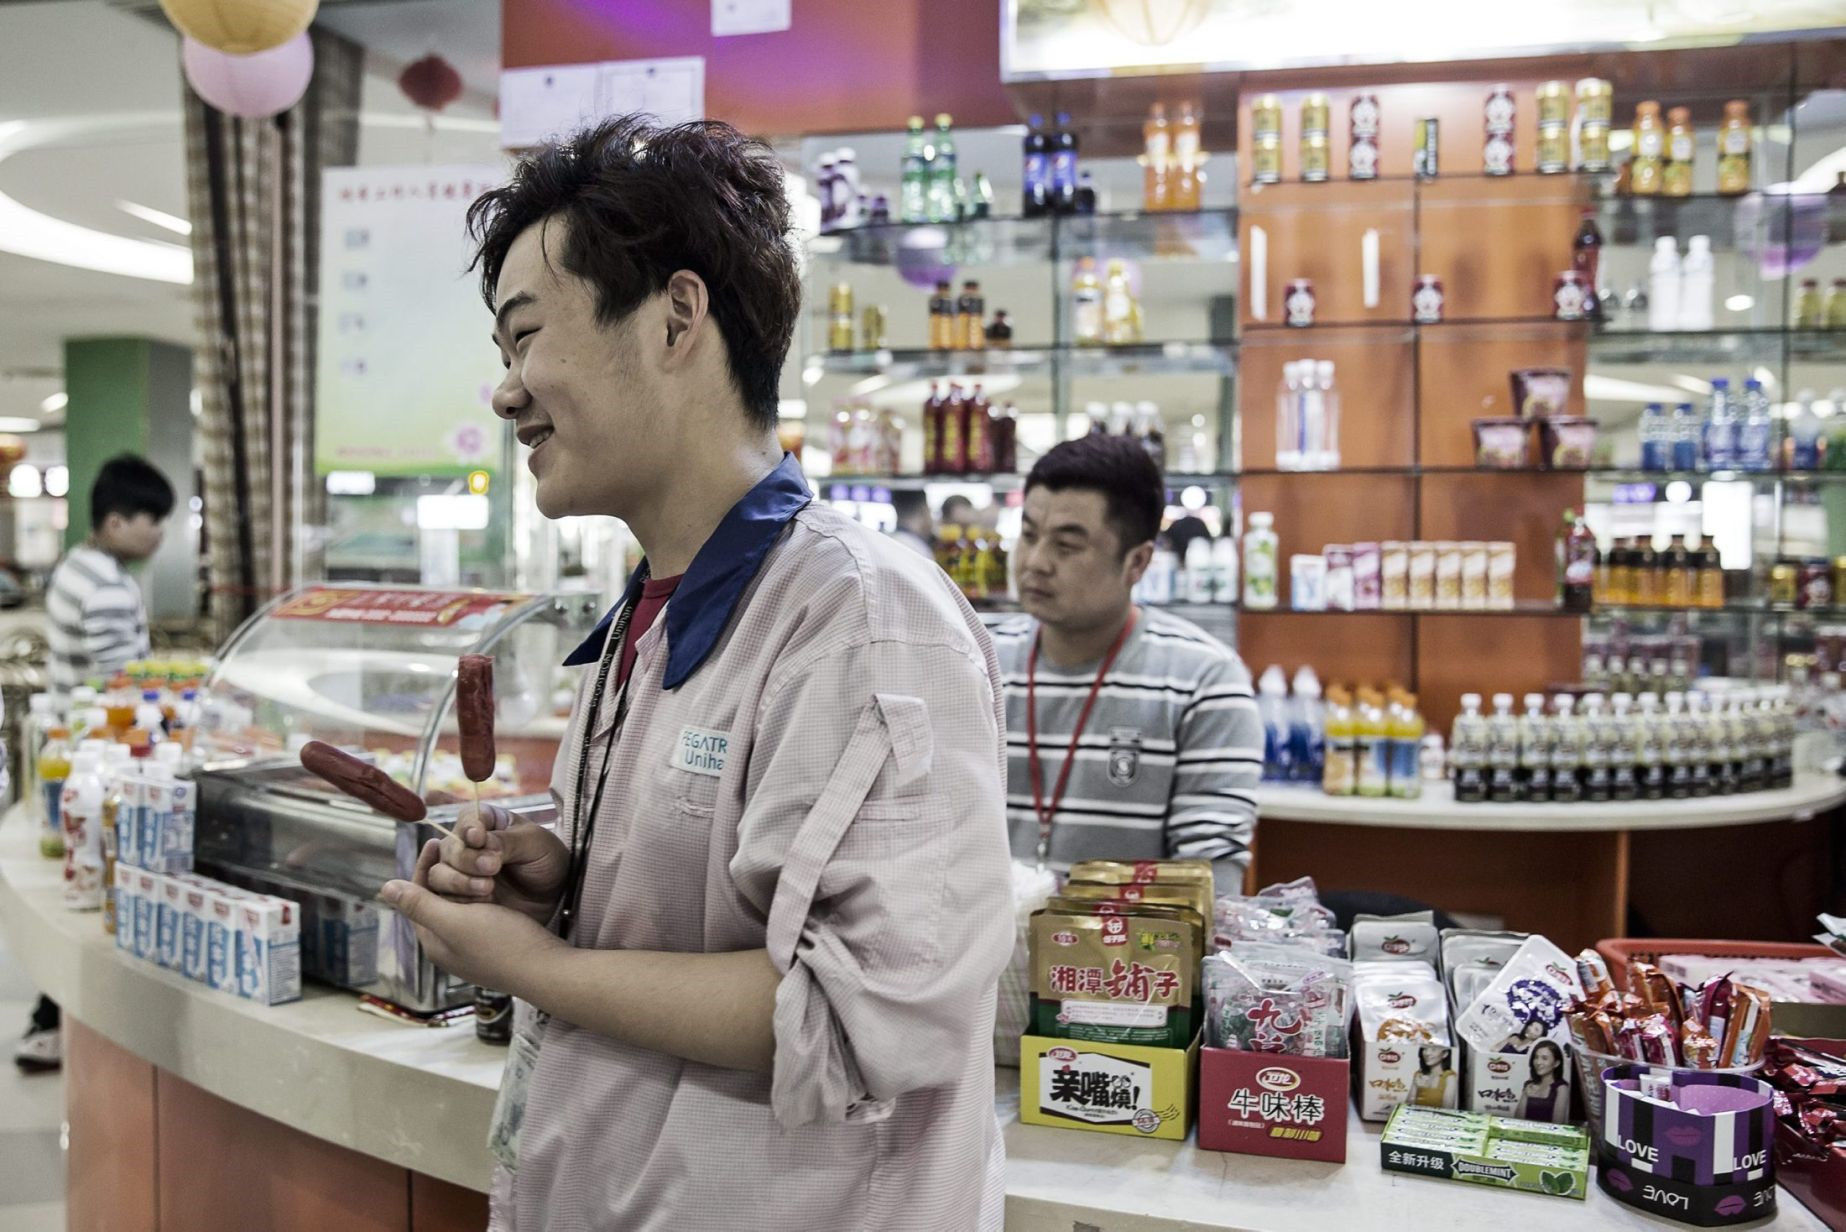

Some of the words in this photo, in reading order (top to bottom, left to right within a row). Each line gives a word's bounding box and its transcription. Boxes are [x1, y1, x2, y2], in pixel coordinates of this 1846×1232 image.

[1229, 1088, 1324, 1124] 牛味棒
[1388, 1150, 1445, 1170] 全新升级
[1617, 1135, 1659, 1162] LOVE
[1457, 1161, 1513, 1179] DOUBLEMINT
[1733, 1150, 1767, 1171] LOVE
[1642, 1185, 1689, 1210] LOVE
